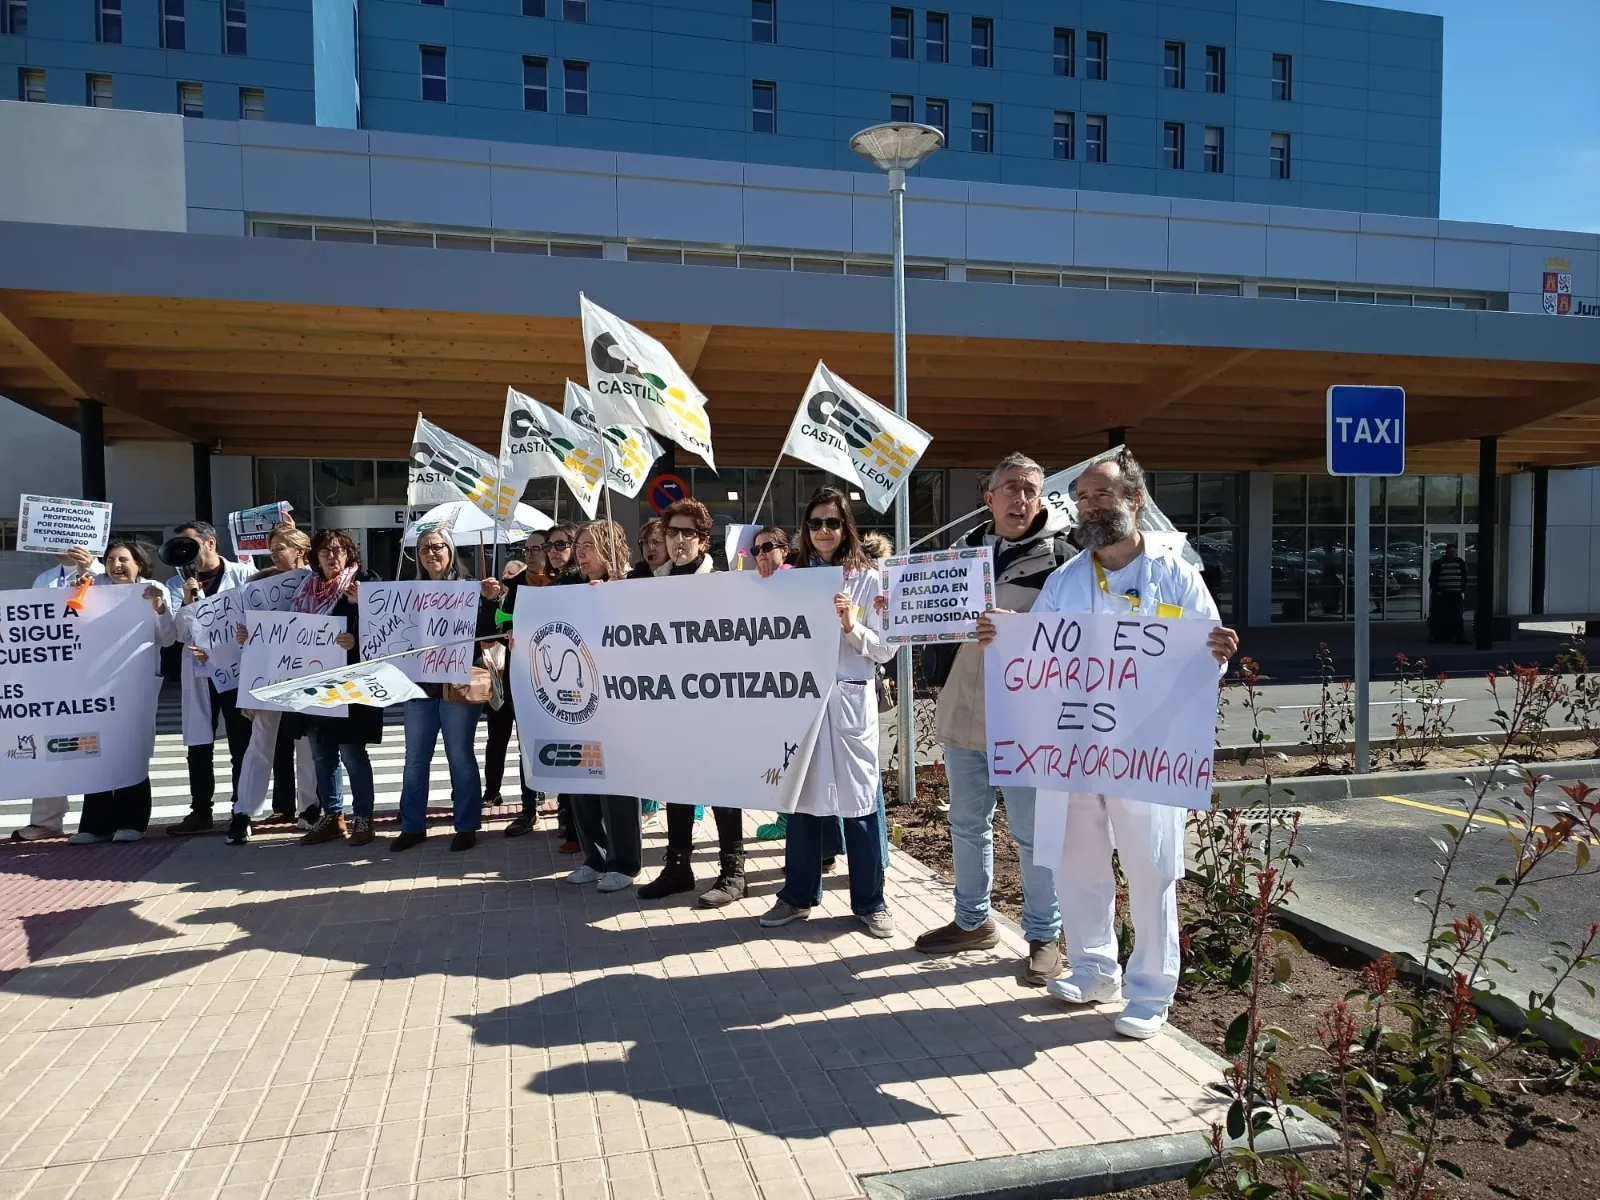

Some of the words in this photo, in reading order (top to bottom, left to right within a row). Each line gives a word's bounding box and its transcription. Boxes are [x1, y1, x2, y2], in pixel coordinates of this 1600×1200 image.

[1335, 417, 1400, 444] TAXI
[610, 466, 636, 489] LEÓN
[859, 462, 894, 491] LEÓN
[42, 506, 94, 516] CLASIFICACIÓN
[43, 514, 92, 523] PROFESIONAL
[33, 528, 98, 539] RESPONSABILIDAD
[53, 523, 96, 531] FORMACIÓN
[49, 537, 88, 545] LIDERAZGO
[899, 567, 967, 583] JUBILACIÓN
[902, 584, 949, 597] BASADA
[952, 582, 968, 593] EN
[7, 603, 55, 621] ESTE
[368, 589, 413, 615] SIN
[412, 591, 476, 612] NEGOCIAR
[901, 601, 914, 611] EL
[916, 598, 958, 609] RIESGO
[960, 597, 969, 606] Y
[426, 616, 449, 637] NO
[894, 616, 909, 625] LA
[911, 611, 980, 624] PENOSIDAD
[9, 623, 81, 643] SIGUE,
[249, 622, 265, 645] A
[269, 617, 297, 645] MÍ
[362, 614, 405, 661] ESCUCHA
[555, 623, 563, 634] EN
[562, 625, 581, 648] HUELGA
[601, 622, 668, 647] HORA
[669, 615, 812, 647] TRABAJADA
[1032, 618, 1082, 653] NO
[1113, 621, 1168, 656] ES
[277, 655, 303, 671] ME
[602, 674, 676, 700] HORA
[681, 671, 821, 699] COTIZADA
[1004, 657, 1139, 693] GUARDIA
[536, 687, 549, 705] POR
[545, 700, 557, 714] UN
[1057, 701, 1117, 732] ES
[538, 743, 603, 767] CESM
[993, 740, 1213, 789] EXTRAORDINARIA
